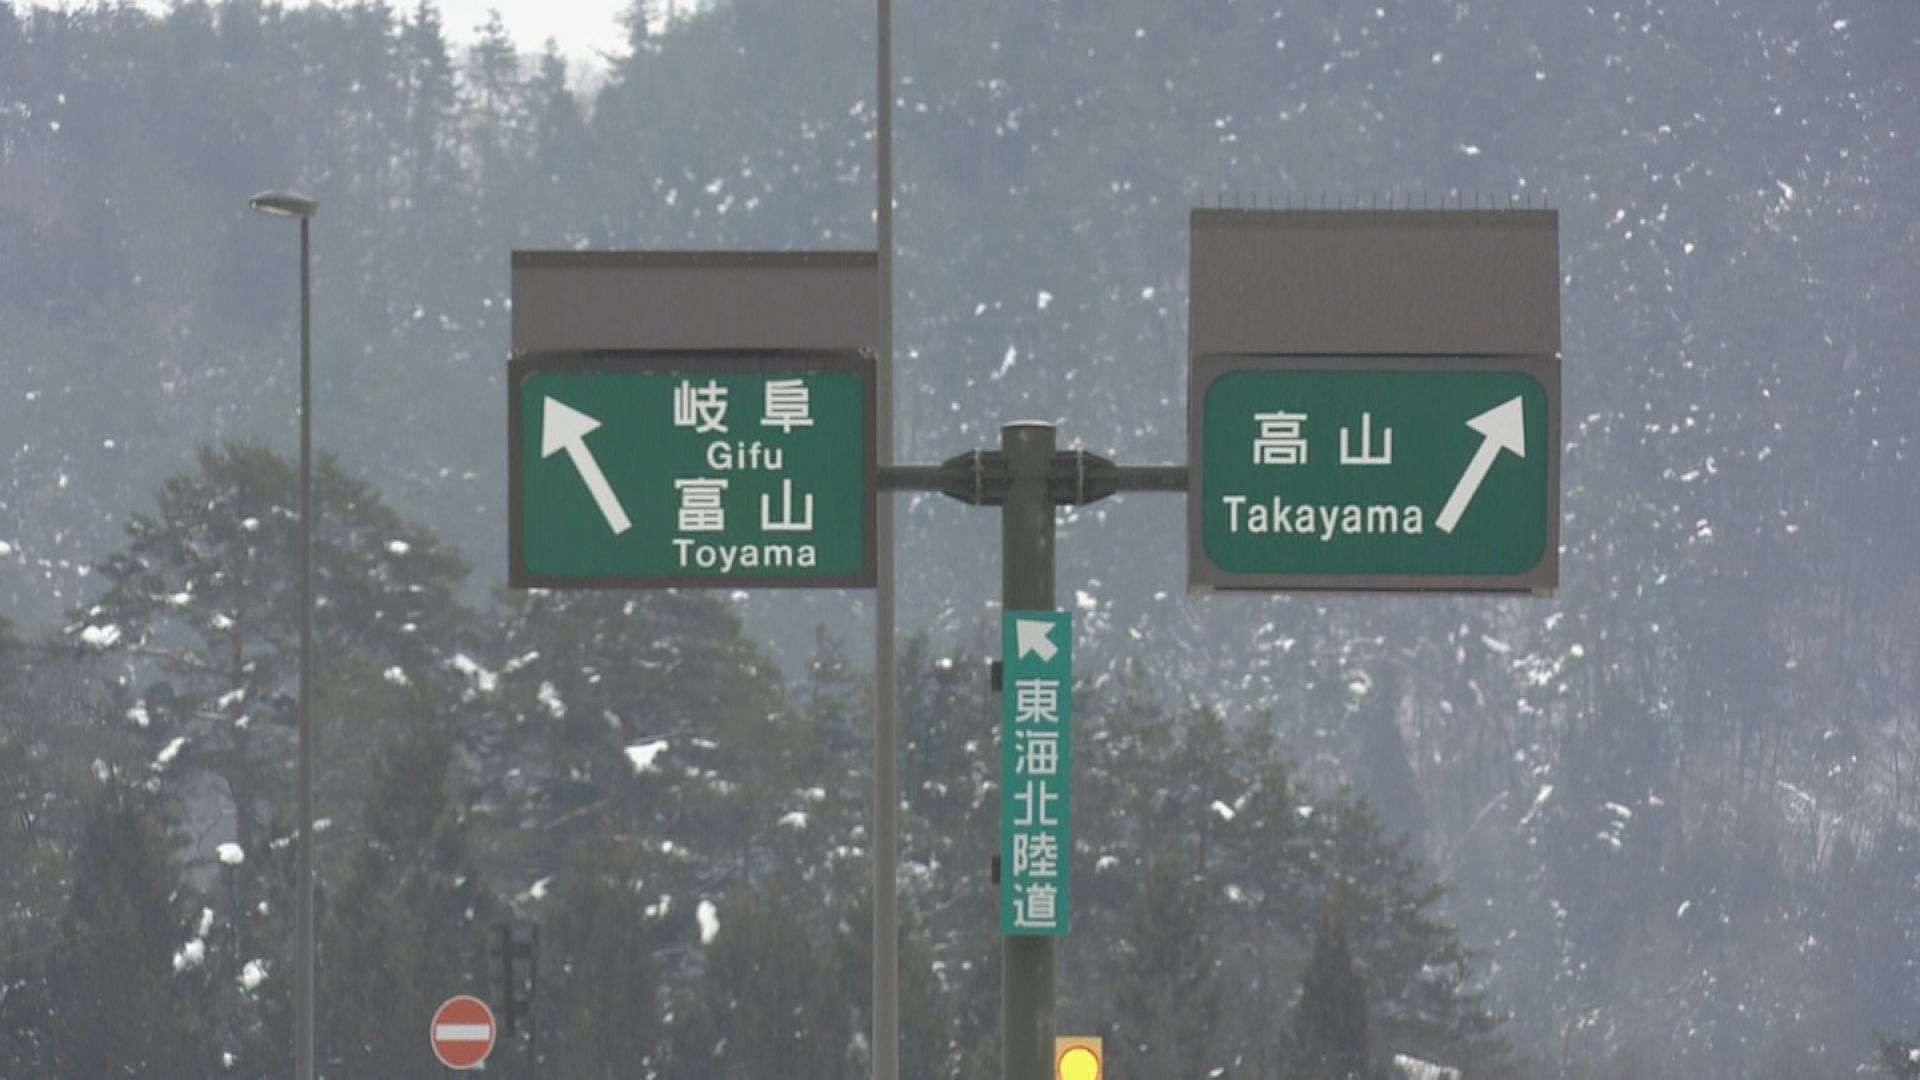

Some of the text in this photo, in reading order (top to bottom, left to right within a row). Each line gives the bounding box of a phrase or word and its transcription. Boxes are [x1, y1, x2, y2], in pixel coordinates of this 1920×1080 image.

[673, 378, 814, 434] 岐阜
[706, 441, 783, 470] Gifu
[1253, 410, 1393, 465] 高山
[673, 476, 813, 532] 富山
[1222, 495, 1424, 541] Takayama
[672, 538, 816, 574] Toyama
[1012, 678, 1060, 928] 東海北陸道
